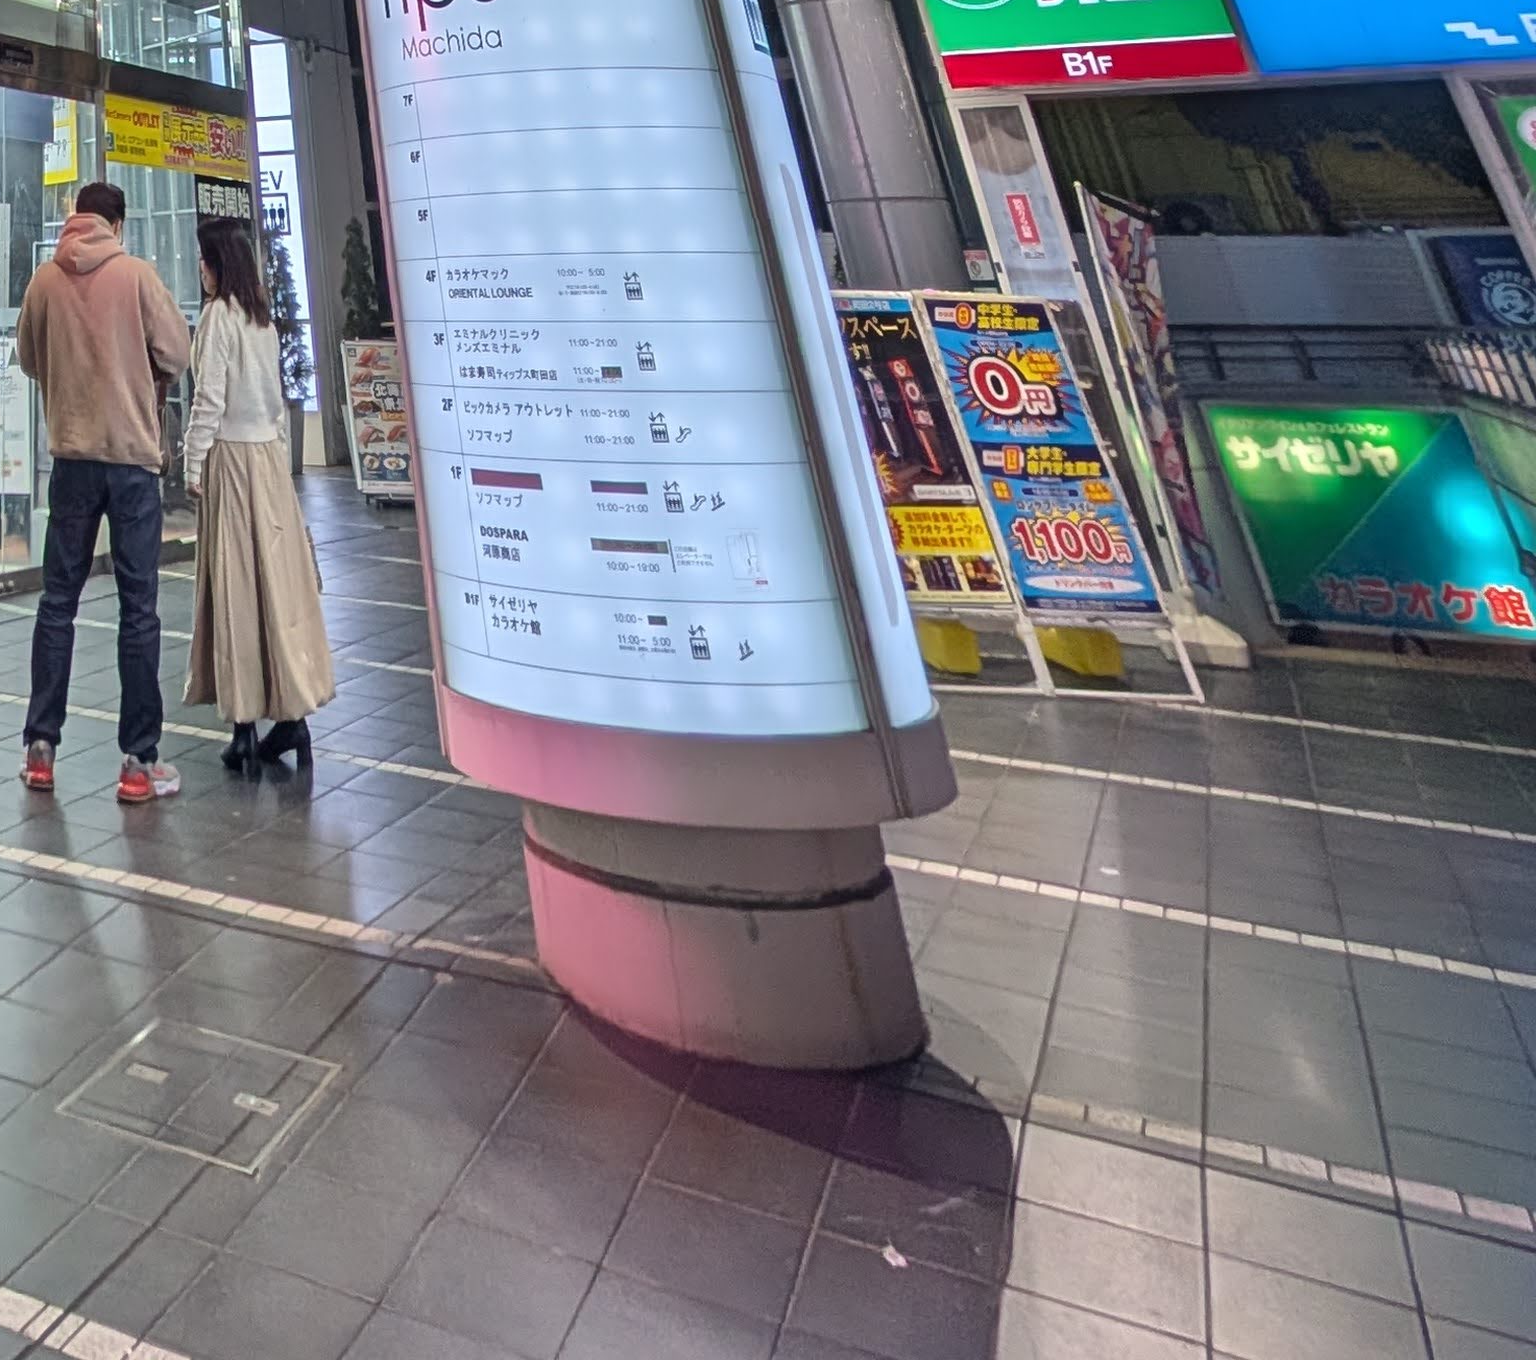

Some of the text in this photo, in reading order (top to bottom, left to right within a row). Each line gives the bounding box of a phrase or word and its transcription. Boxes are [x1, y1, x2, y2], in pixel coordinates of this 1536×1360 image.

[402, 26, 504, 61] Machida
[1062, 51, 1113, 77] B1F
[403, 94, 413, 106] 7F
[410, 151, 421, 163] 6F
[198, 183, 250, 218] 販売開始
[418, 210, 428, 222] 5F
[426, 270, 436, 282] 4F
[446, 268, 509, 281] カラオケマック
[448, 287, 533, 299] ORIENTAL LOUNGE
[433, 333, 444, 345] 3F
[454, 329, 540, 340] エミナルクリニック
[840, 317, 917, 340] スペース
[456, 342, 521, 354] メンズエミナル
[969, 356, 1057, 416] 0円
[441, 398, 453, 411] 2F
[464, 401, 510, 415] ビックカメラ
[515, 402, 573, 417] アウトレット
[467, 429, 512, 443] ソフマップ
[1225, 435, 1400, 477] サイゼリヤ
[451, 466, 462, 479] 1F
[476, 493, 523, 508] ソフマップ
[480, 525, 529, 542] DOSPARA
[1013, 518, 1133, 564] 1,100円
[464, 592, 479, 606] B1F
[489, 595, 537, 614] サイゼリヤ
[1318, 571, 1535, 629] カラオケ館
[492, 614, 541, 636] カラオケ館
